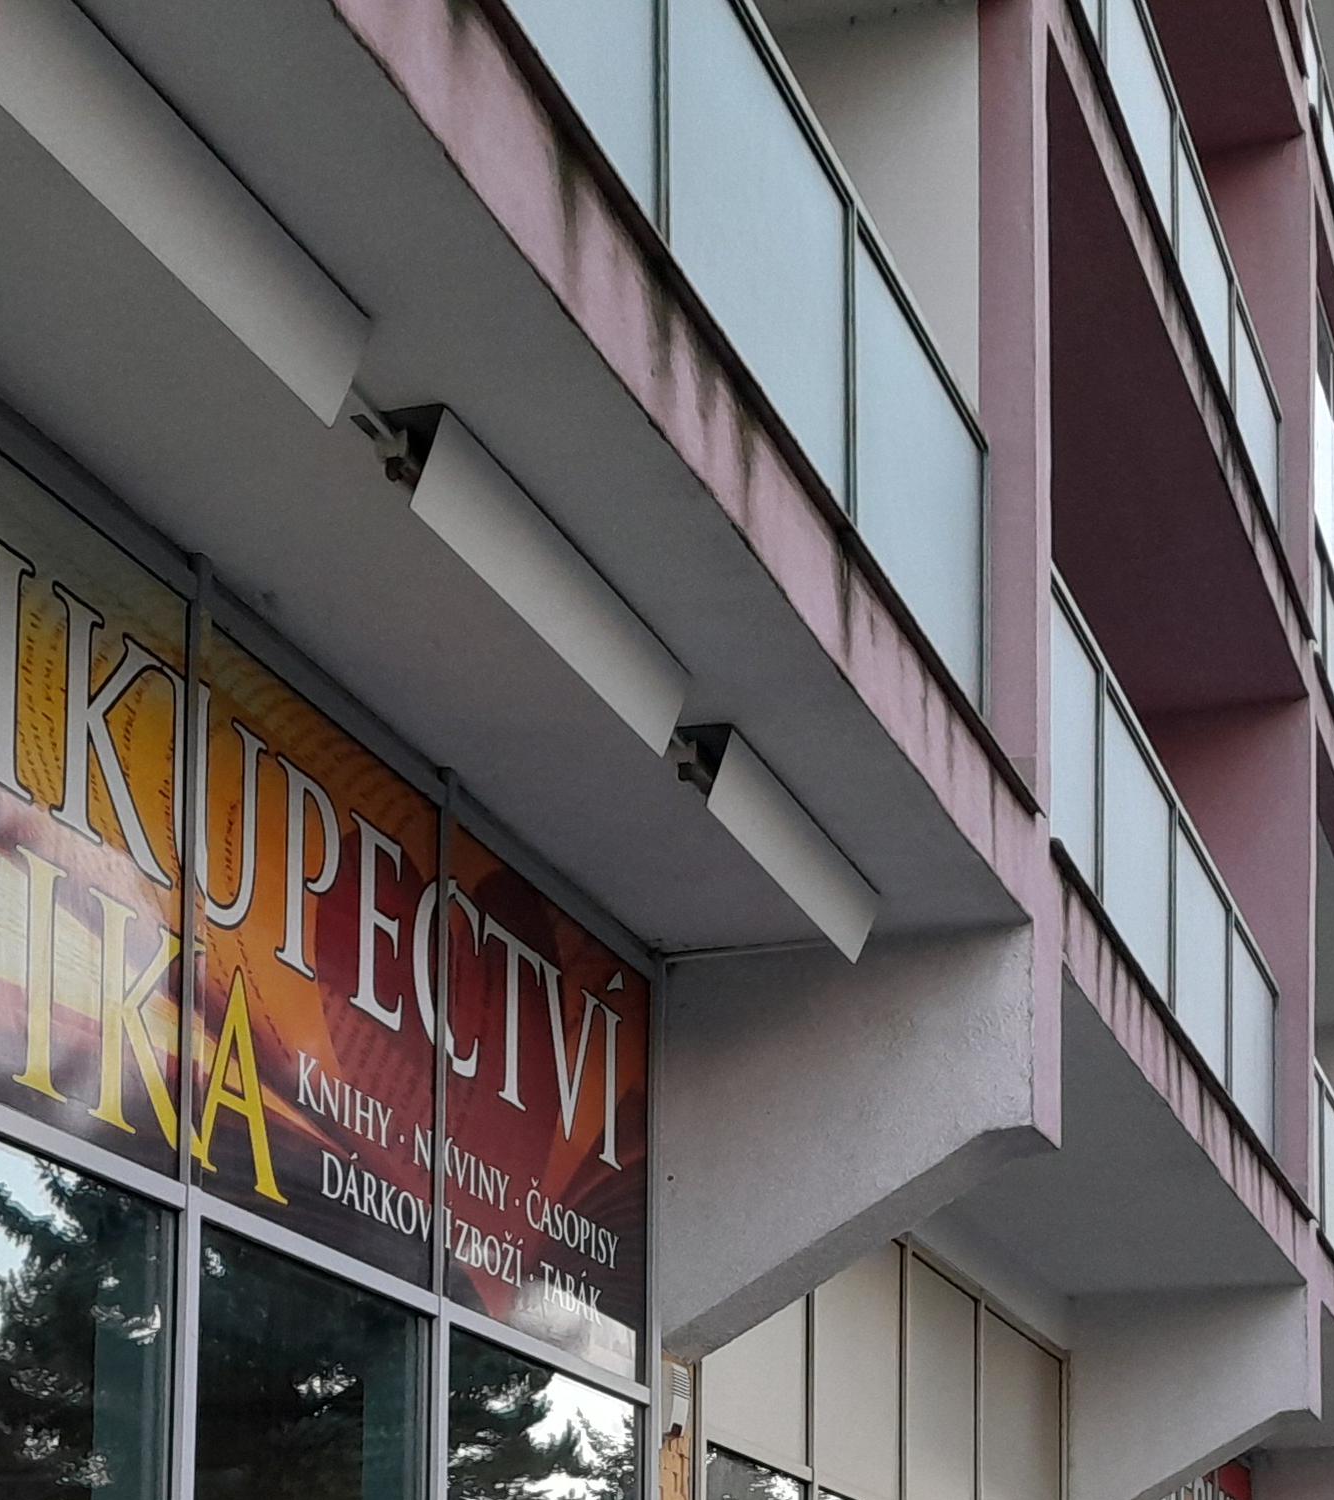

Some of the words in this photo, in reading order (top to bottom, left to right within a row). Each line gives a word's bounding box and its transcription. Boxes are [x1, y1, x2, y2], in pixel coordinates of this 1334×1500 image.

[297, 1049, 394, 1149] KNIHY
[525, 1177, 620, 1270] ČASOPISY
[454, 1220, 524, 1289] ZBOŽÍ
[539, 1261, 603, 1328] TABÁK
